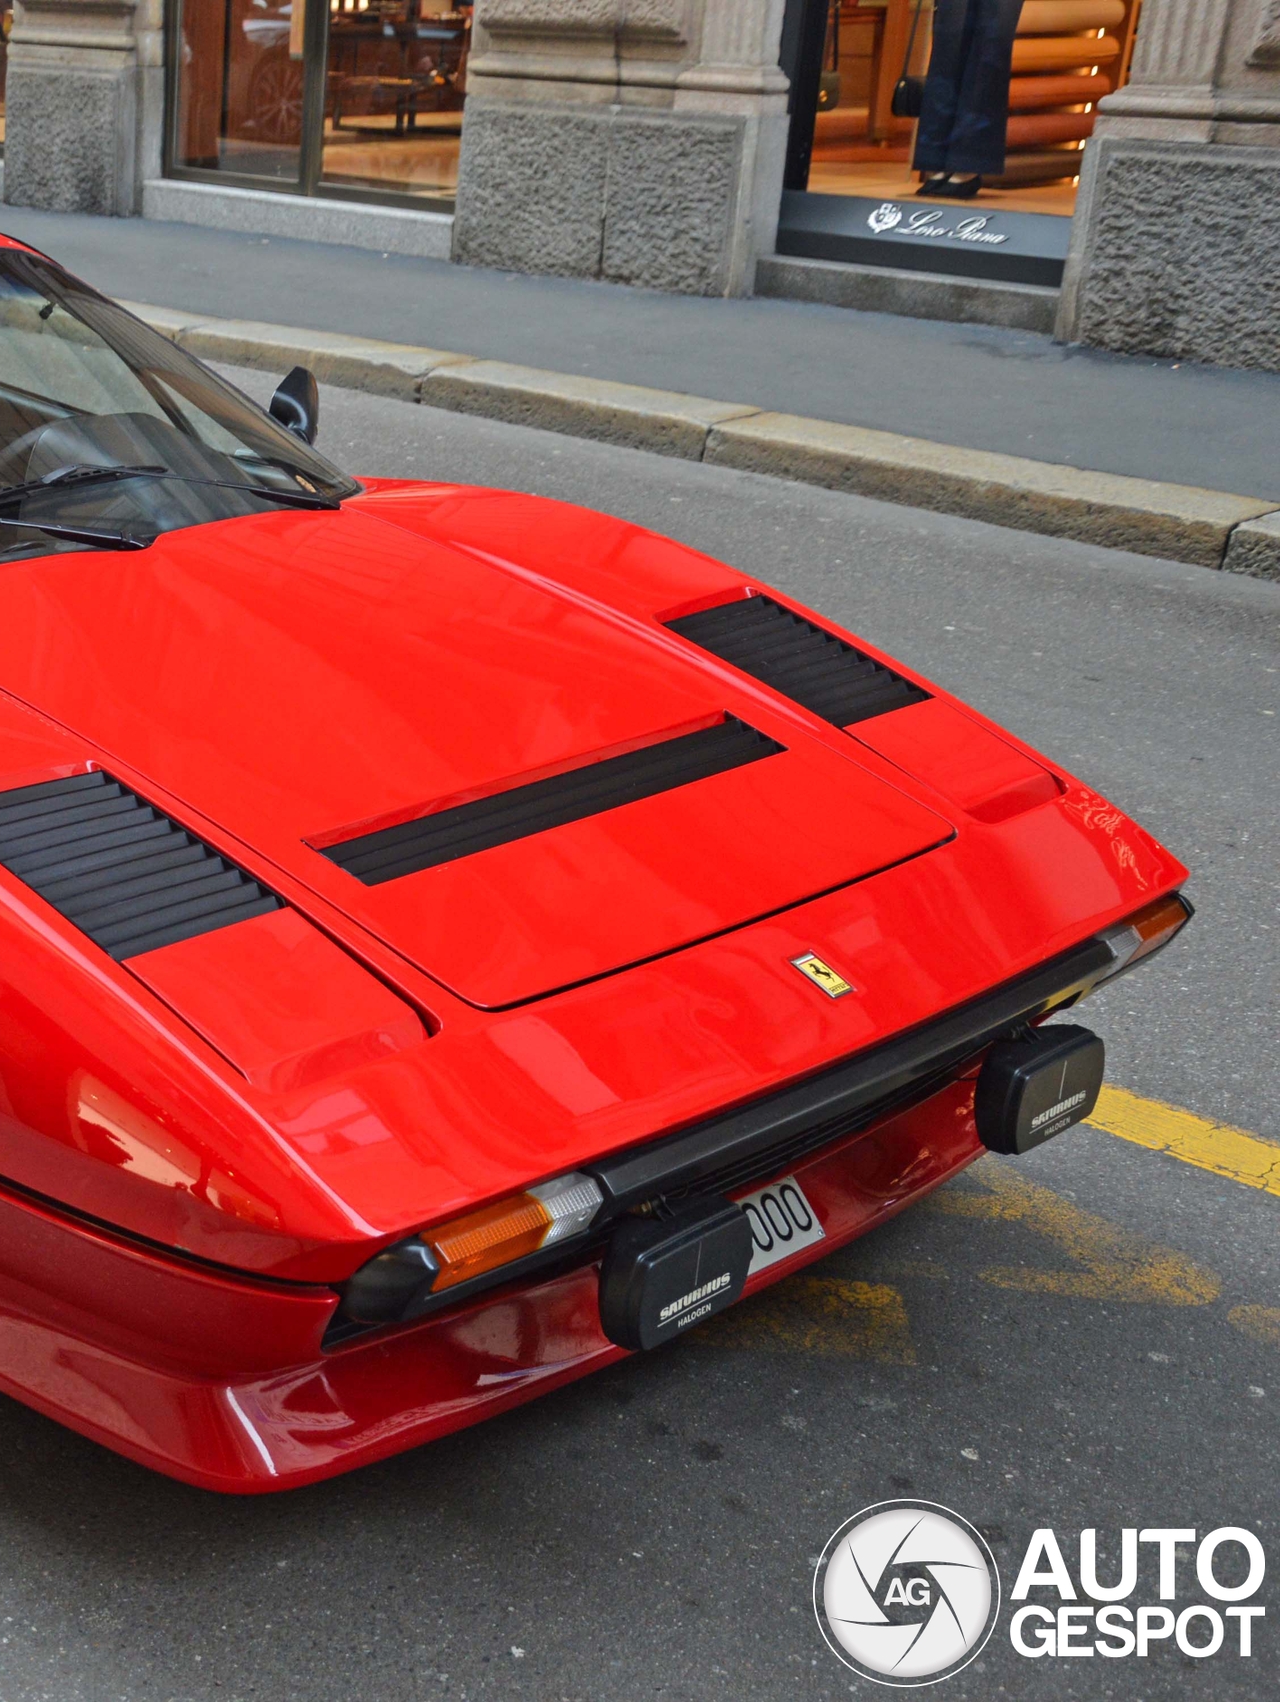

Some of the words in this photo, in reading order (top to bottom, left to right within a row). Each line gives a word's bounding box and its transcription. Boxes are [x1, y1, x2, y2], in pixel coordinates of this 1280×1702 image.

[894, 209, 950, 237] Loro
[947, 214, 1009, 244] Piana
[1031, 1090, 1087, 1129] SATURNUS
[1044, 1116, 1071, 1137] HALOGEN
[659, 1272, 731, 1321] SATURNUS
[677, 1302, 712, 1329] HALOGEN
